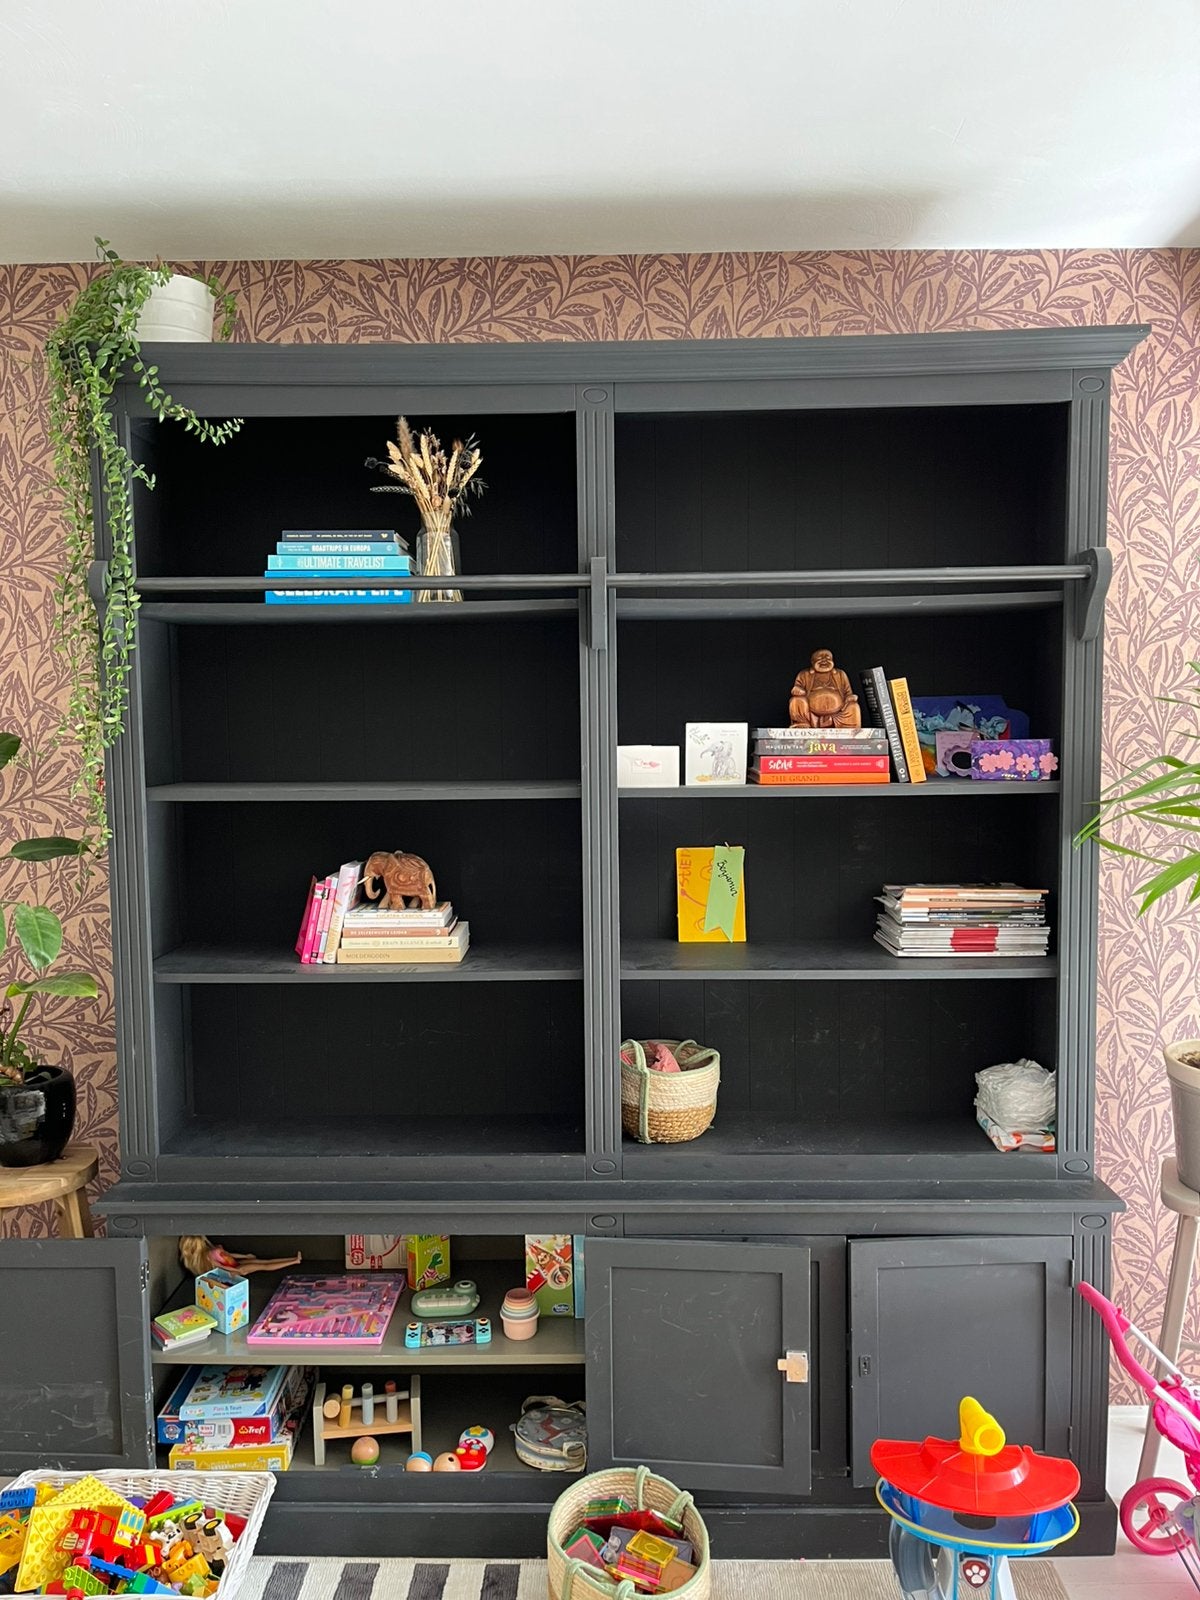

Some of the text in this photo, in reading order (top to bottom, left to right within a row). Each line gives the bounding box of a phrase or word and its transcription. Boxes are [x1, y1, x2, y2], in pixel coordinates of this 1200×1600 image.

[344, 556, 385, 568] TRAVELIST
[882, 703, 895, 726] KLEINE
[808, 741, 837, 754] java
[888, 728, 903, 761] TAARTJES
[248, 1425, 266, 1434] Trefl
